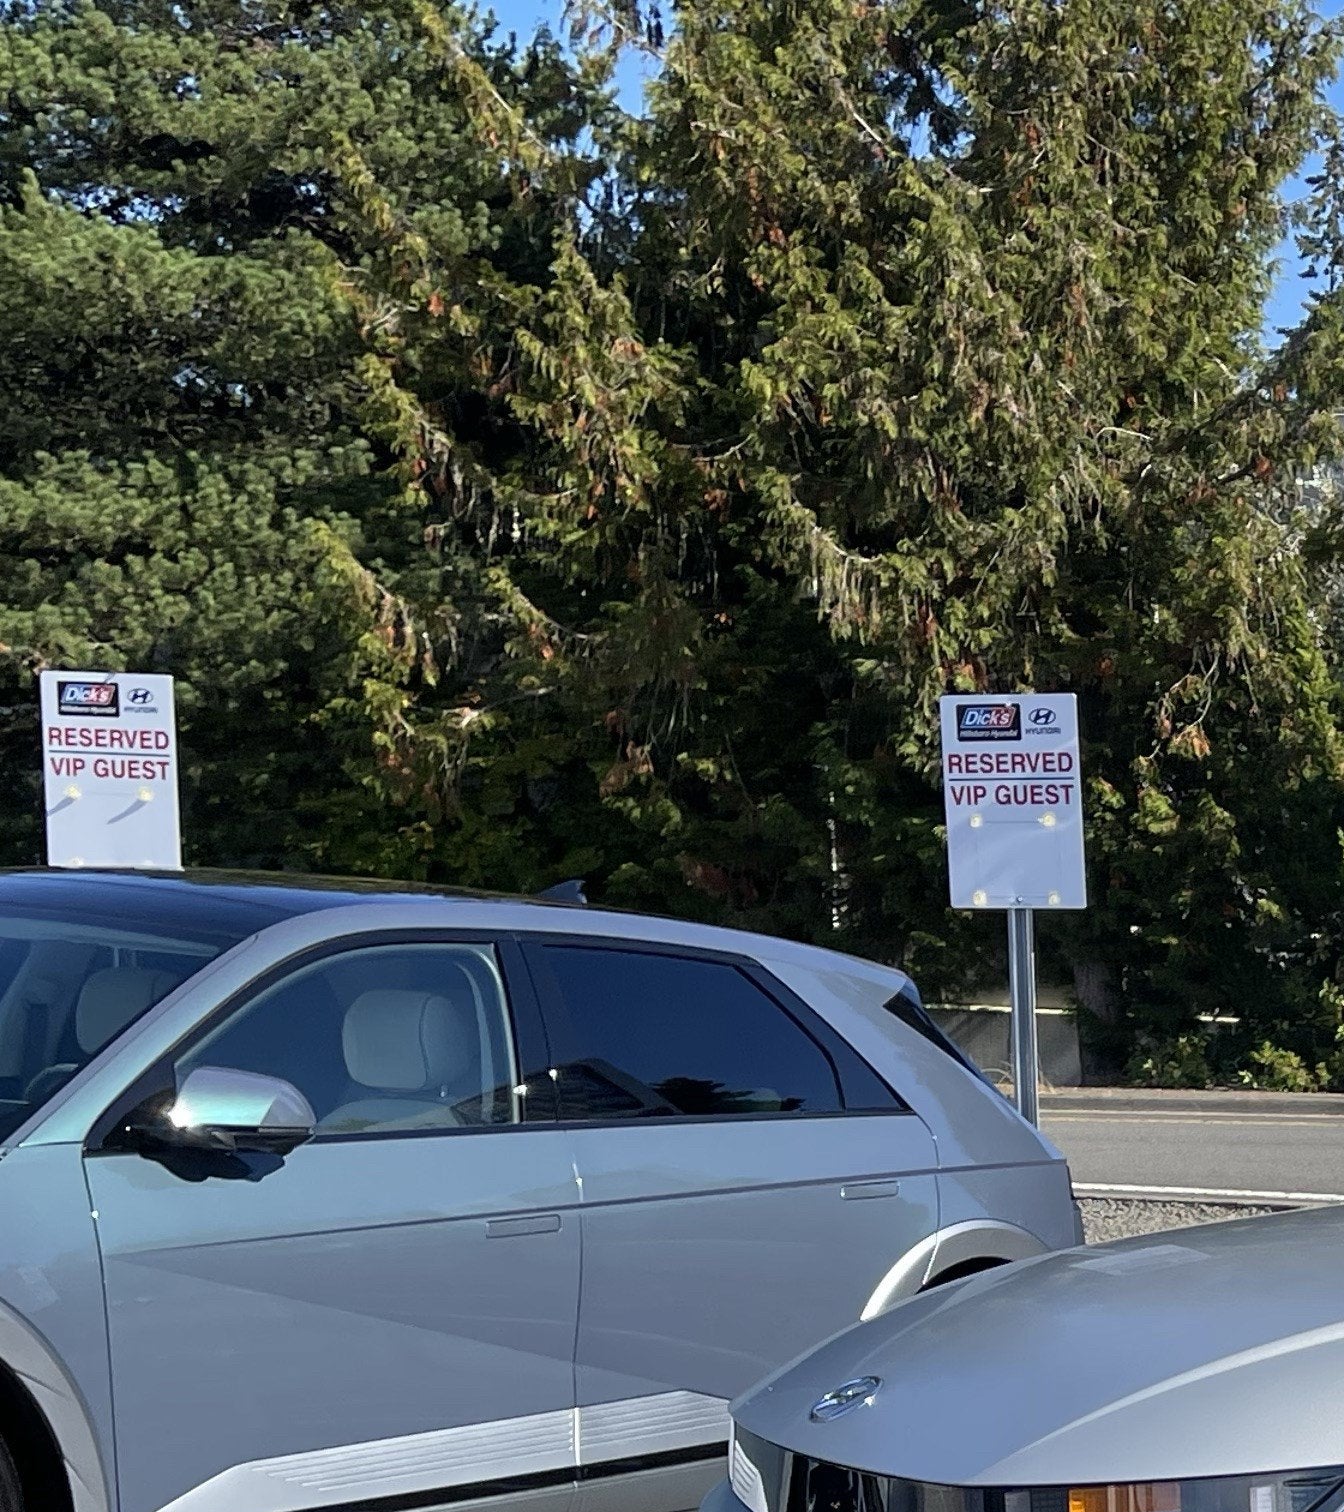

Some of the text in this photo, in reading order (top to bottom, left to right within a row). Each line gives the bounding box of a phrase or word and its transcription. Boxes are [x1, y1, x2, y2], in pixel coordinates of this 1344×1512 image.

[48, 726, 170, 751] RESERVED
[50, 757, 170, 780] VIP GUEST
[948, 752, 1073, 774] RESERVED
[950, 784, 1074, 805] VIP GUEST
